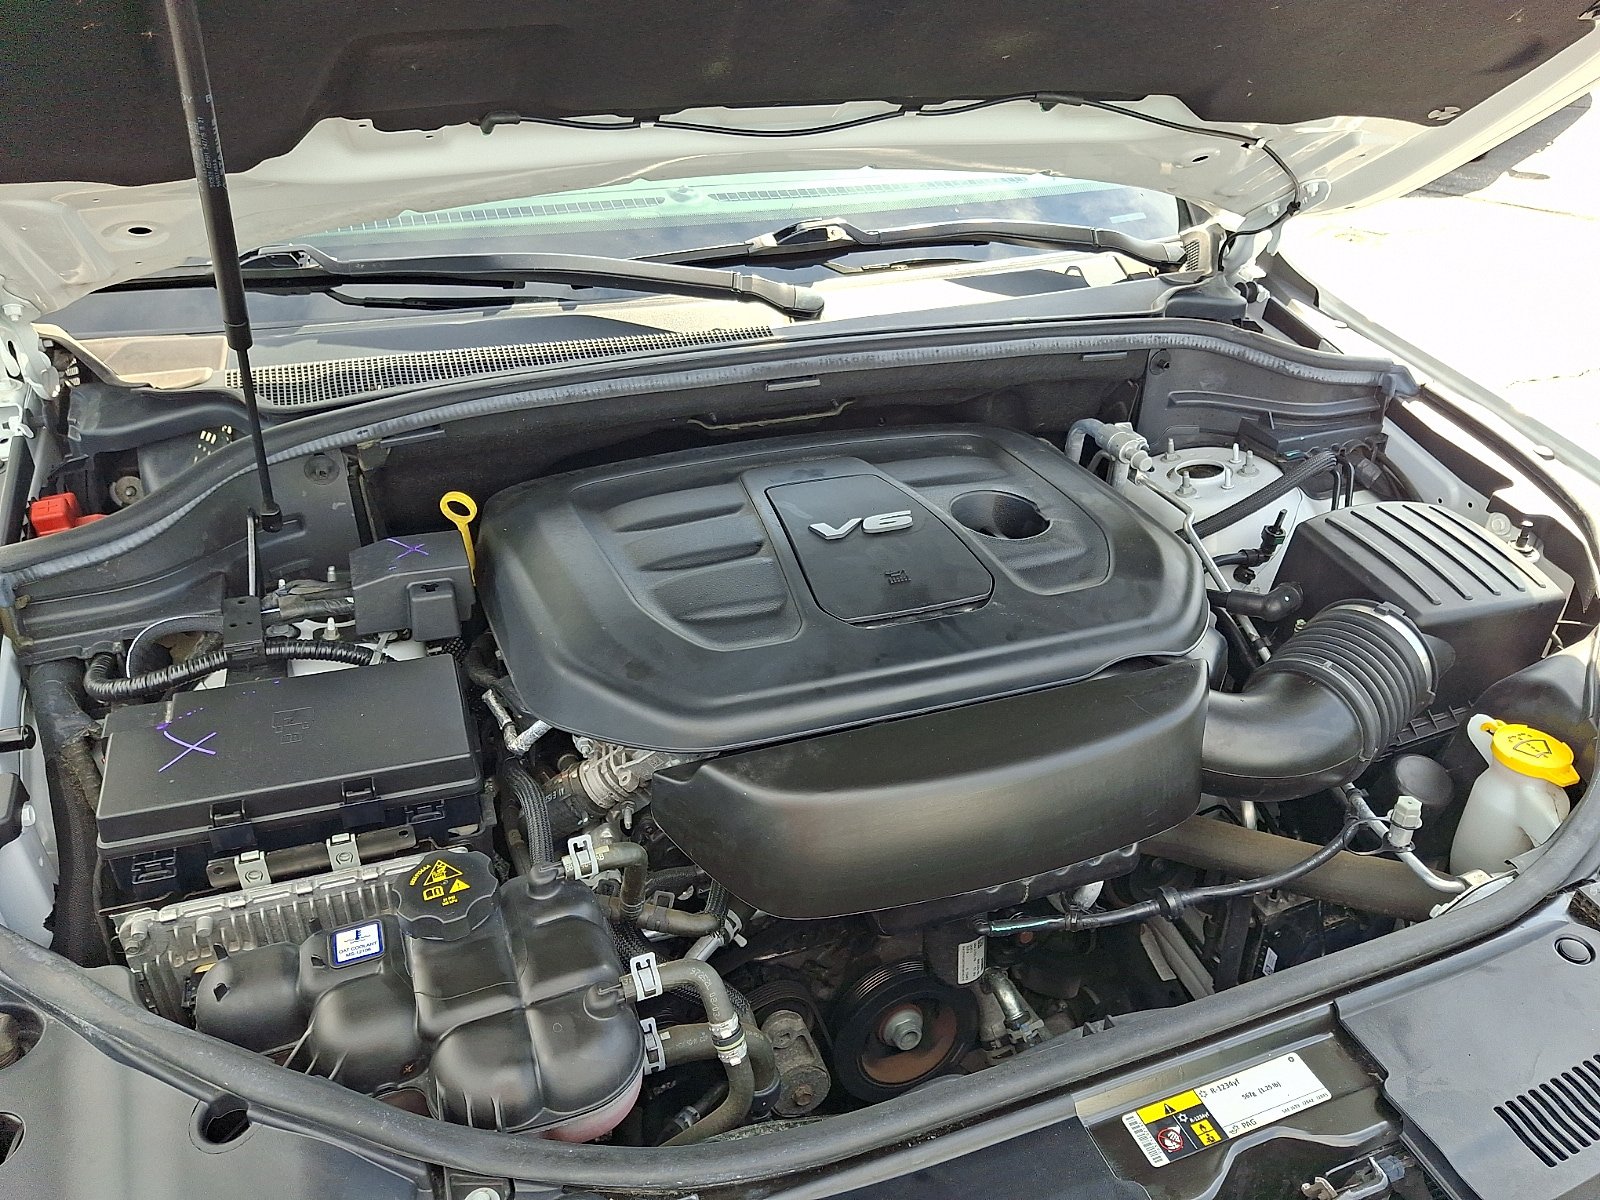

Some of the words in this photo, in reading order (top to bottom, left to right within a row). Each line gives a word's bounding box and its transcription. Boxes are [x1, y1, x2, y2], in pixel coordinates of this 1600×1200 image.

[808, 509, 914, 541] V6
[351, 941, 378, 951] COOLANT
[1210, 1078, 1241, 1094] R-1234yf
[1241, 1118, 1257, 1129] PAG
